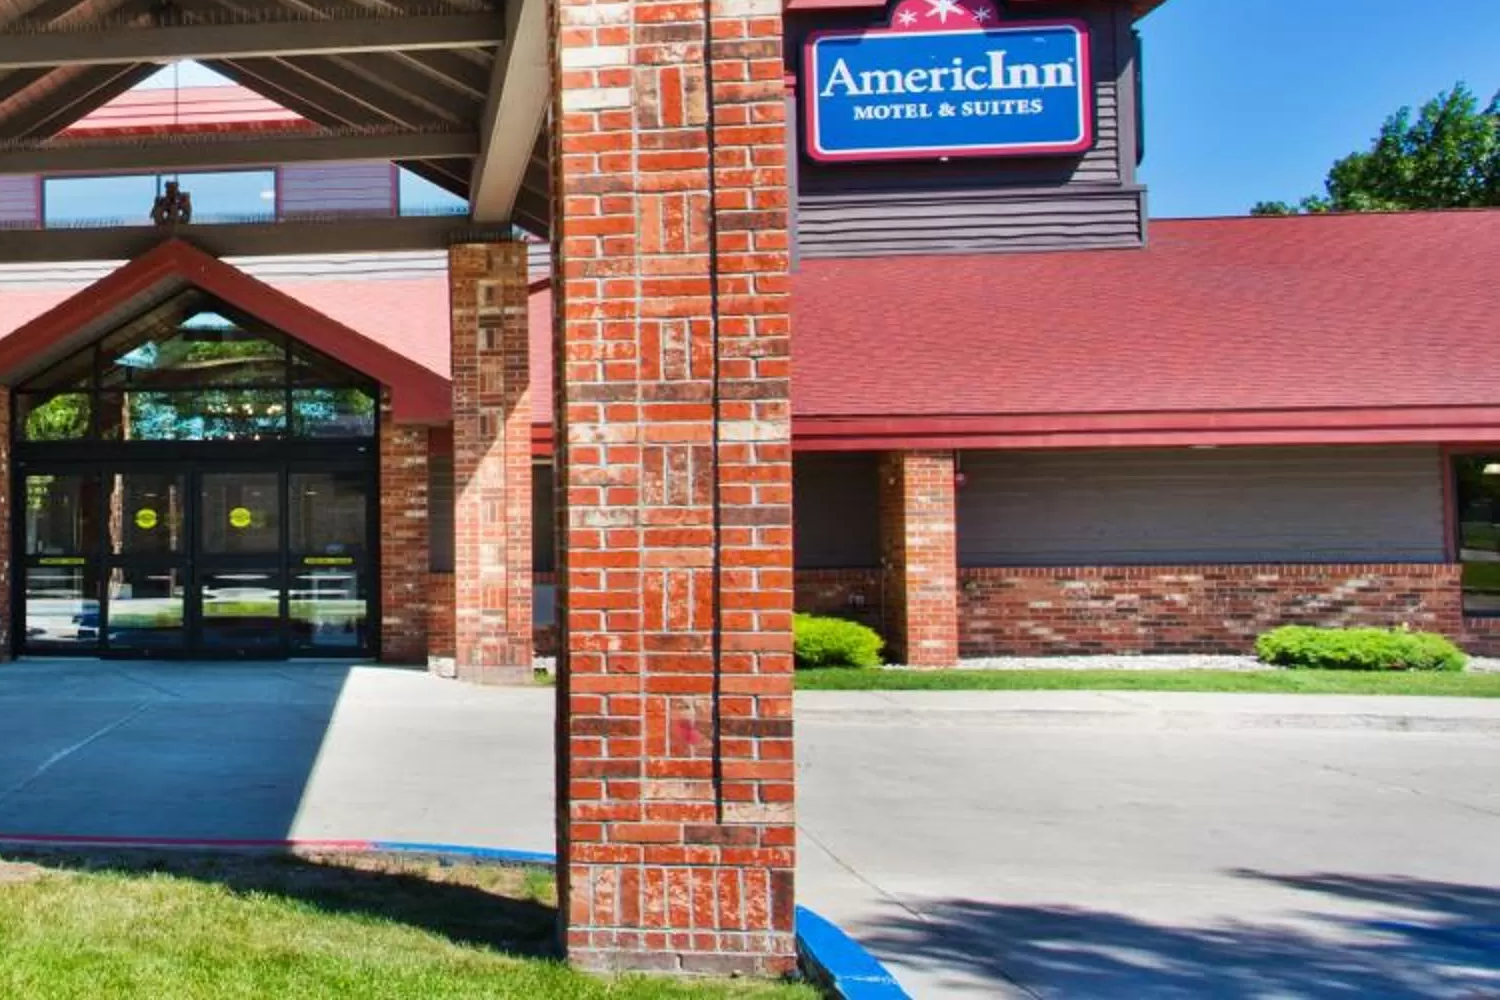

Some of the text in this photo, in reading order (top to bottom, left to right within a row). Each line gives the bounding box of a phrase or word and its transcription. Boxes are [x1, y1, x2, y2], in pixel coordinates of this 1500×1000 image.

[820, 50, 1076, 96] AmericInn
[853, 98, 1043, 120] MOTEL & SUITES
